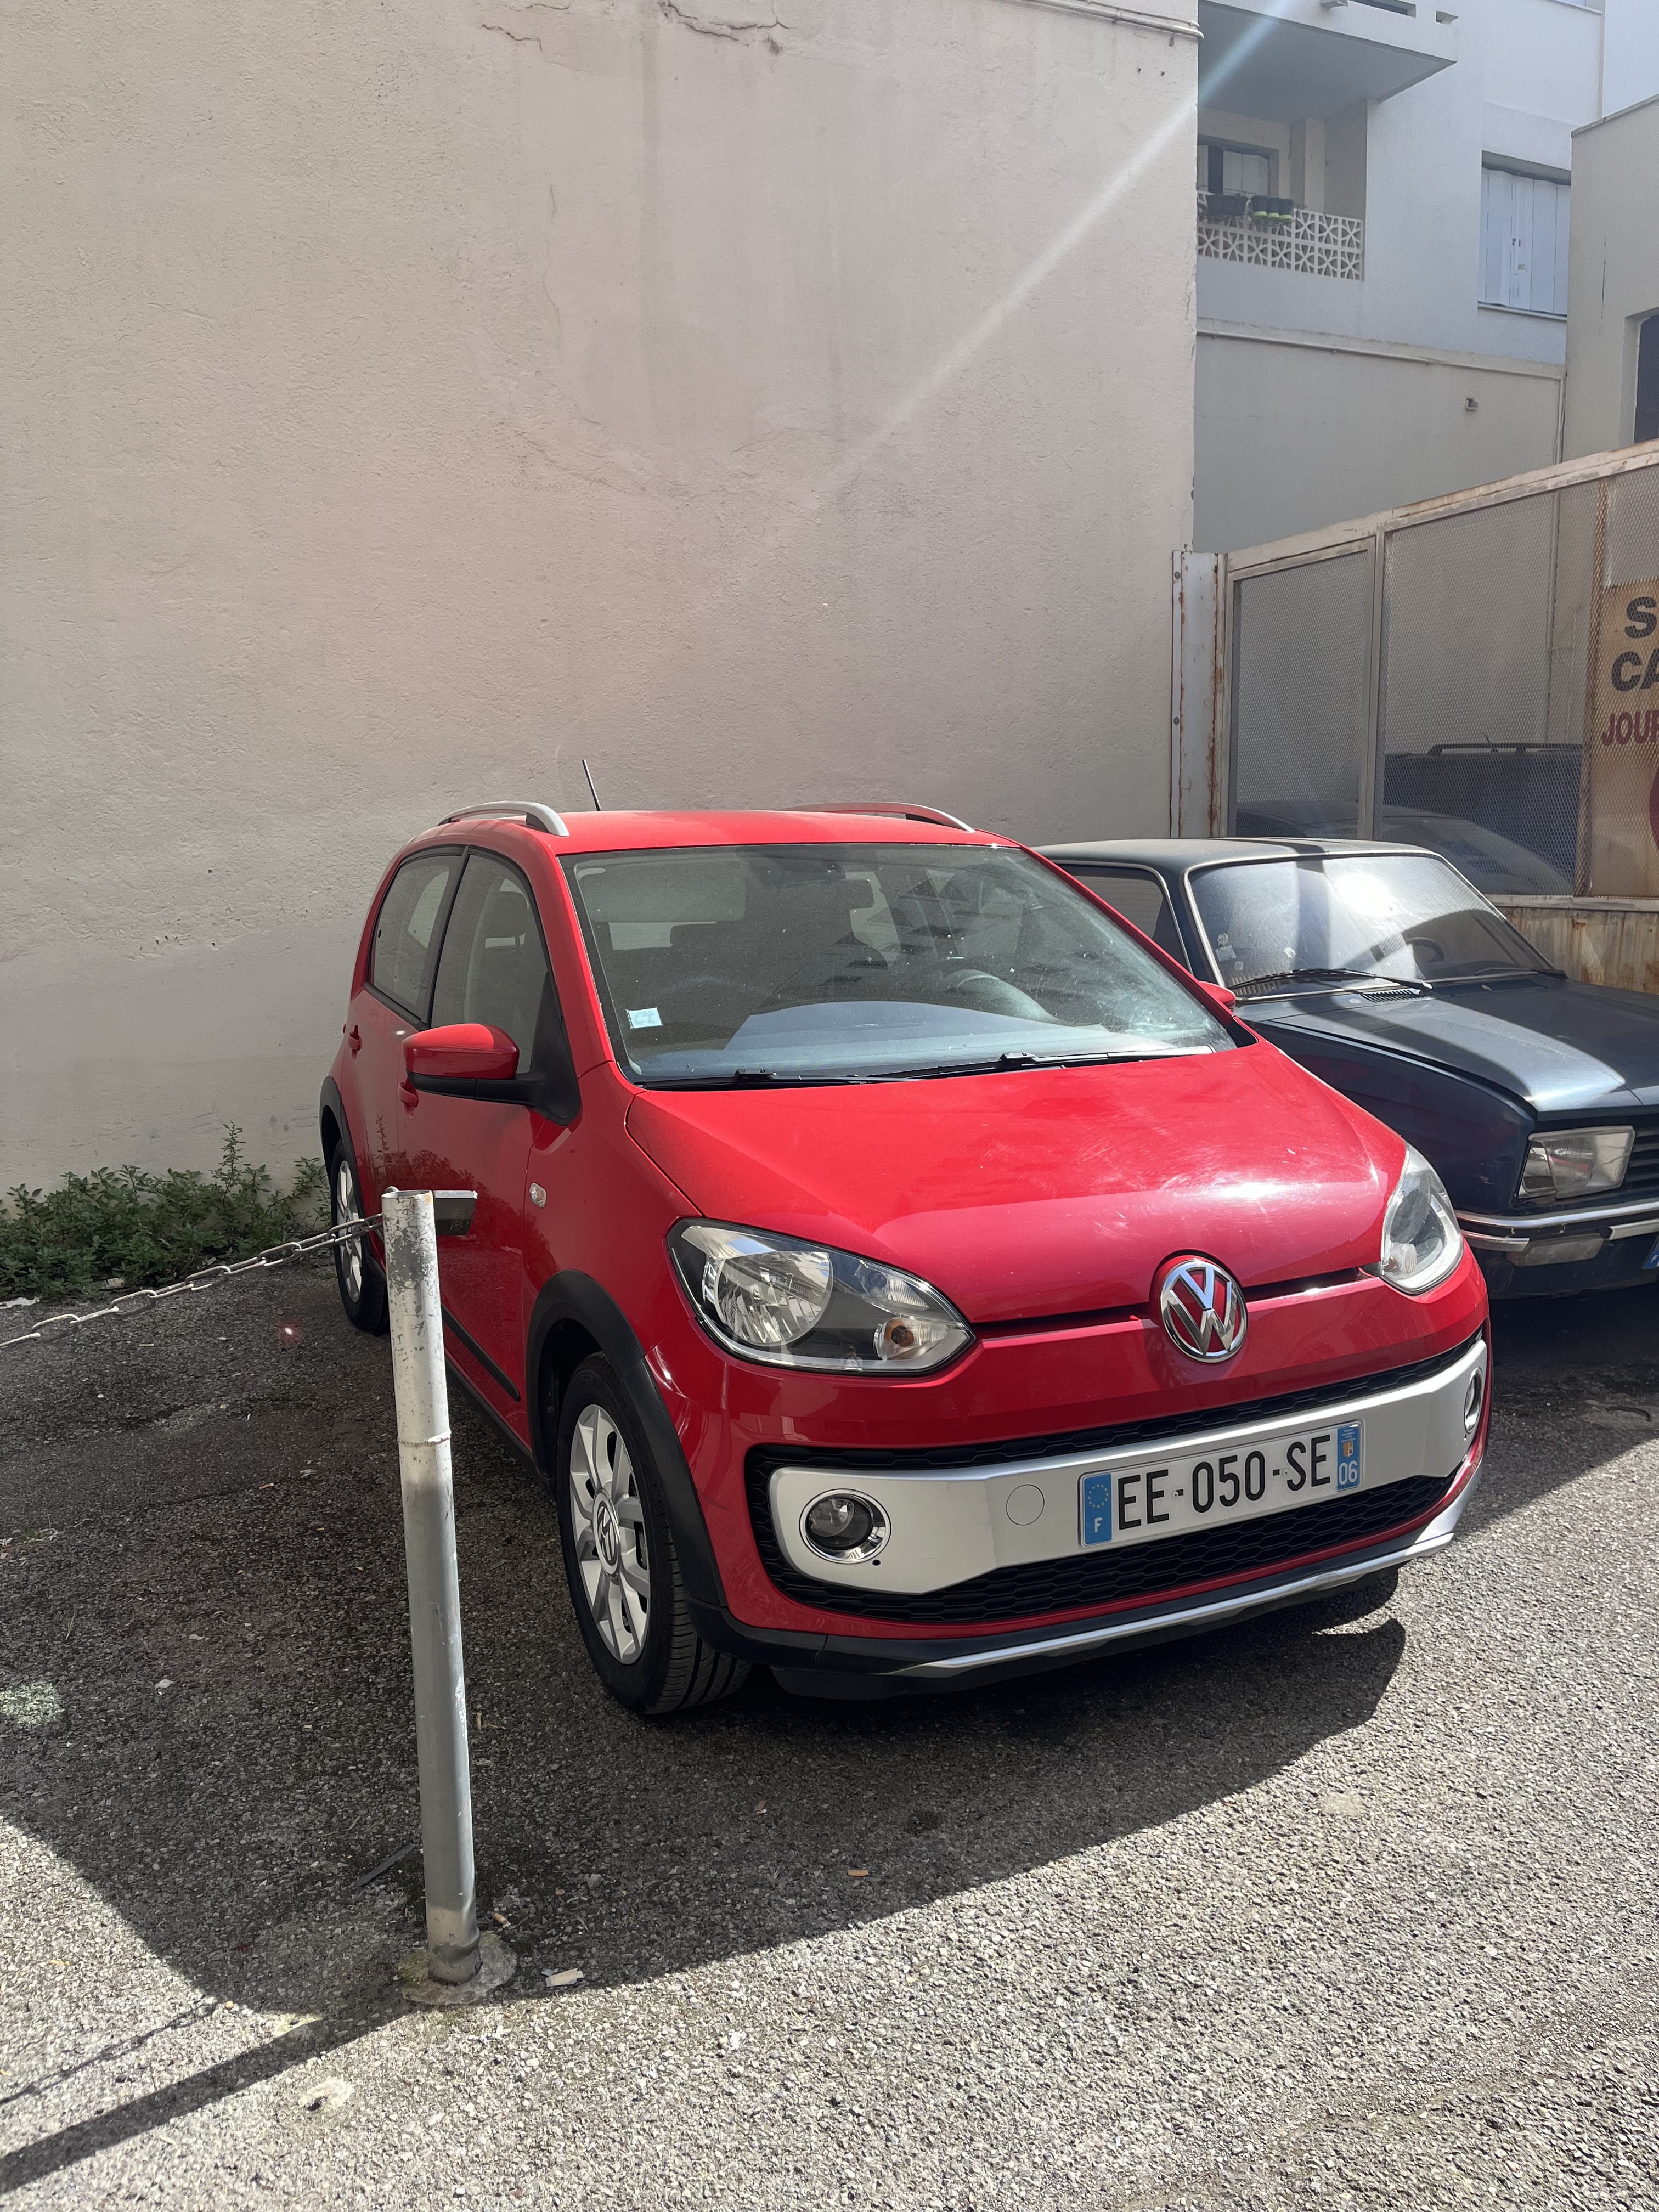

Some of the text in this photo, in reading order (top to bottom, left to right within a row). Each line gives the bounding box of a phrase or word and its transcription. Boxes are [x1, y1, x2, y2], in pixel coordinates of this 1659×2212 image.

[1118, 1434, 1331, 1530] EE-050-SE
[1339, 1460, 1358, 1485] 06
[1094, 1517, 1103, 1533] F
